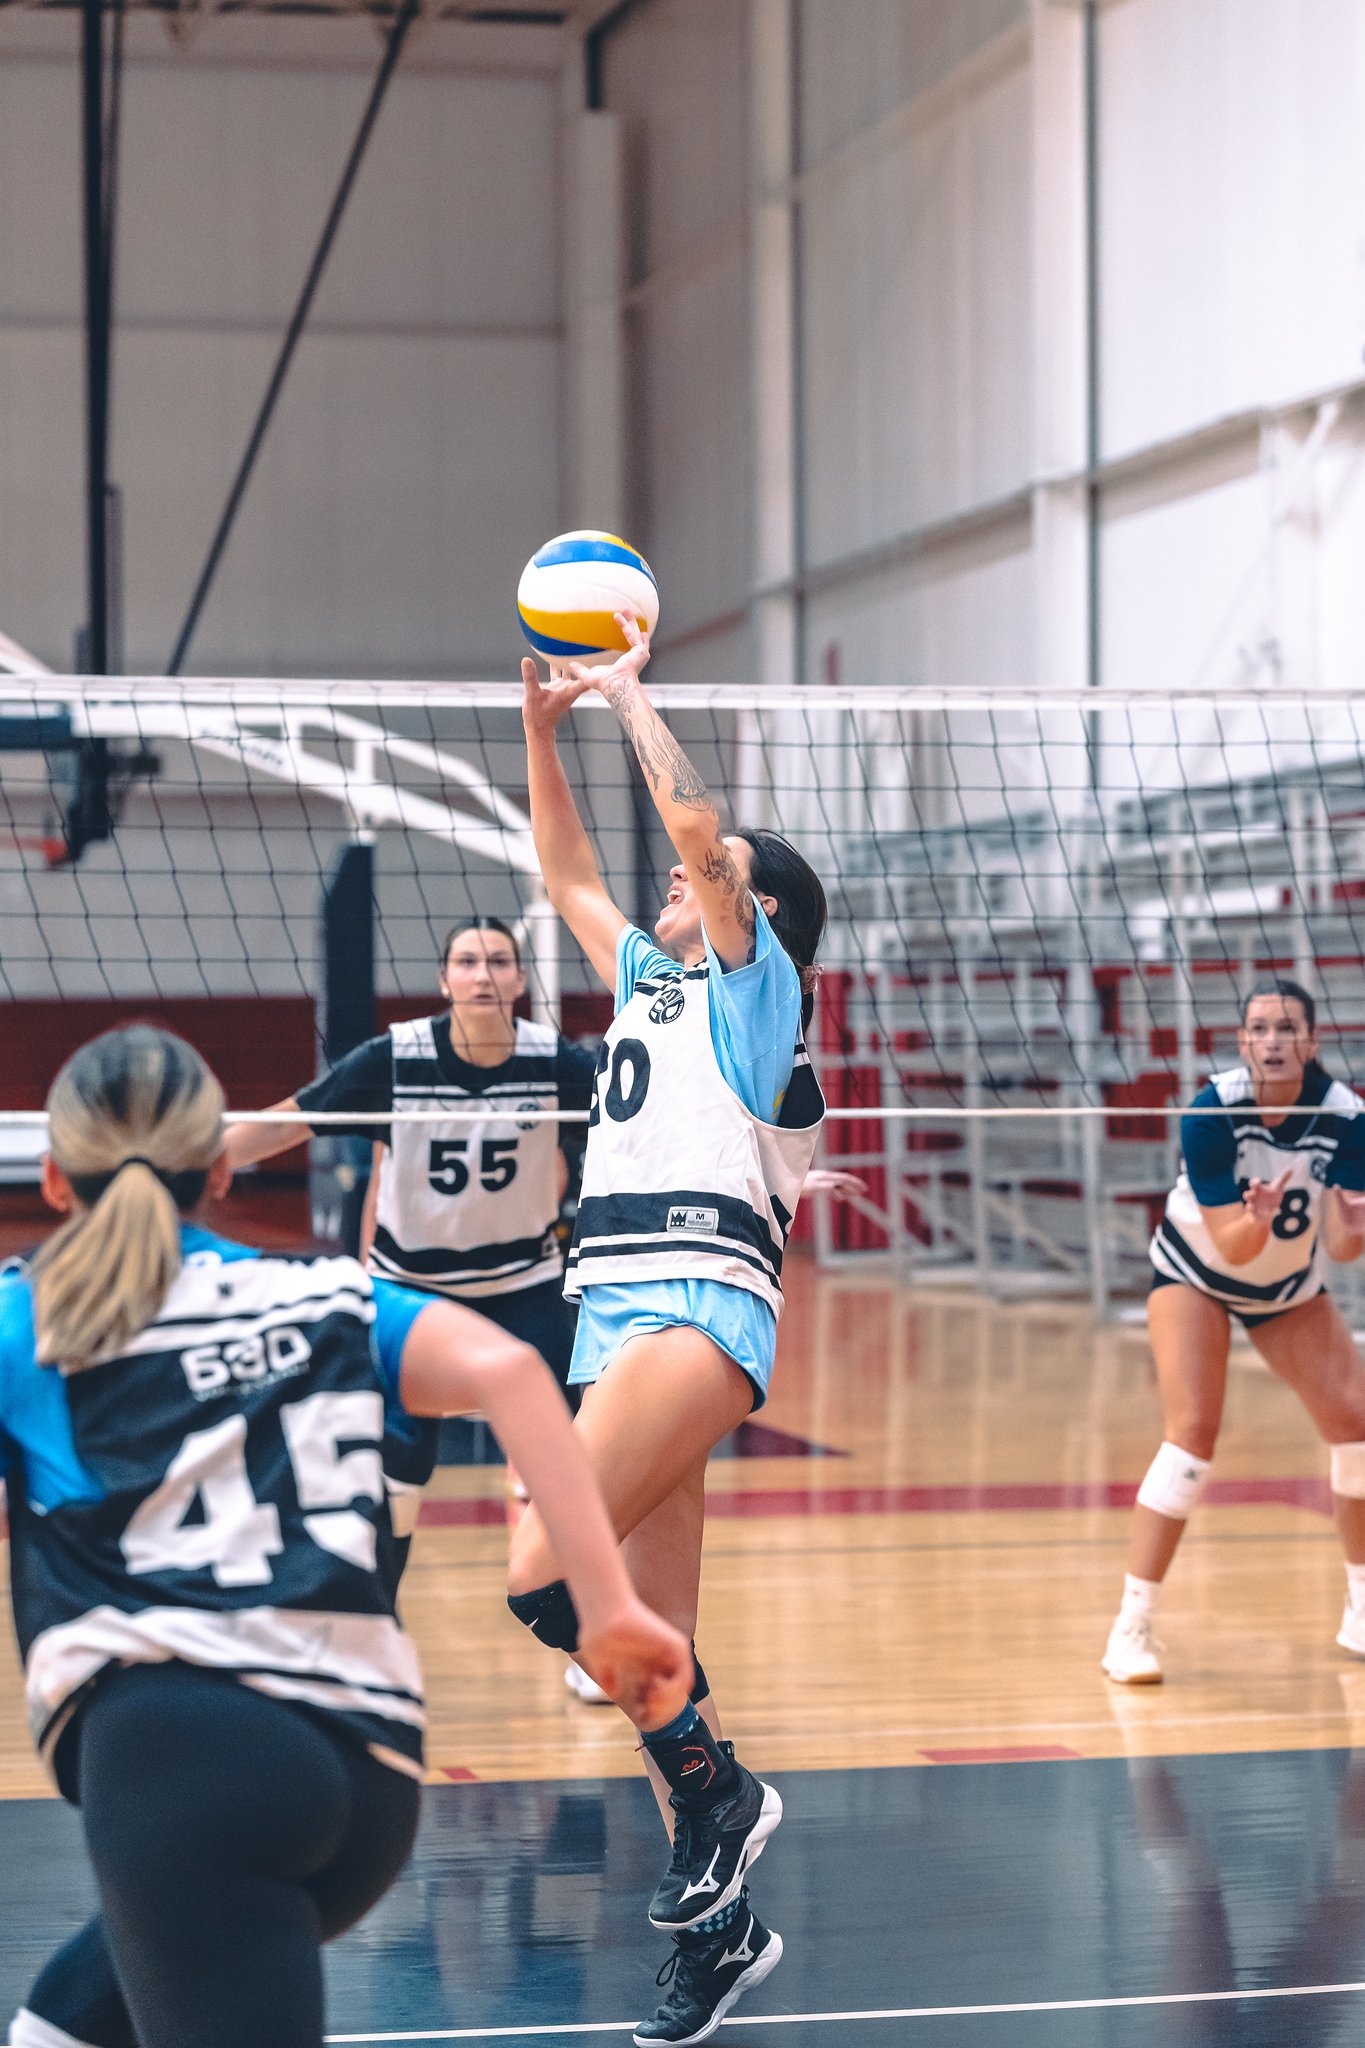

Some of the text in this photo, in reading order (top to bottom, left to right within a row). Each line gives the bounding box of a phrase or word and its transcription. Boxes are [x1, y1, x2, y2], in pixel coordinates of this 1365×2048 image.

[429, 1140, 518, 1195] 55
[1239, 1178, 1310, 1239] 8
[119, 1390, 384, 1588] 45
